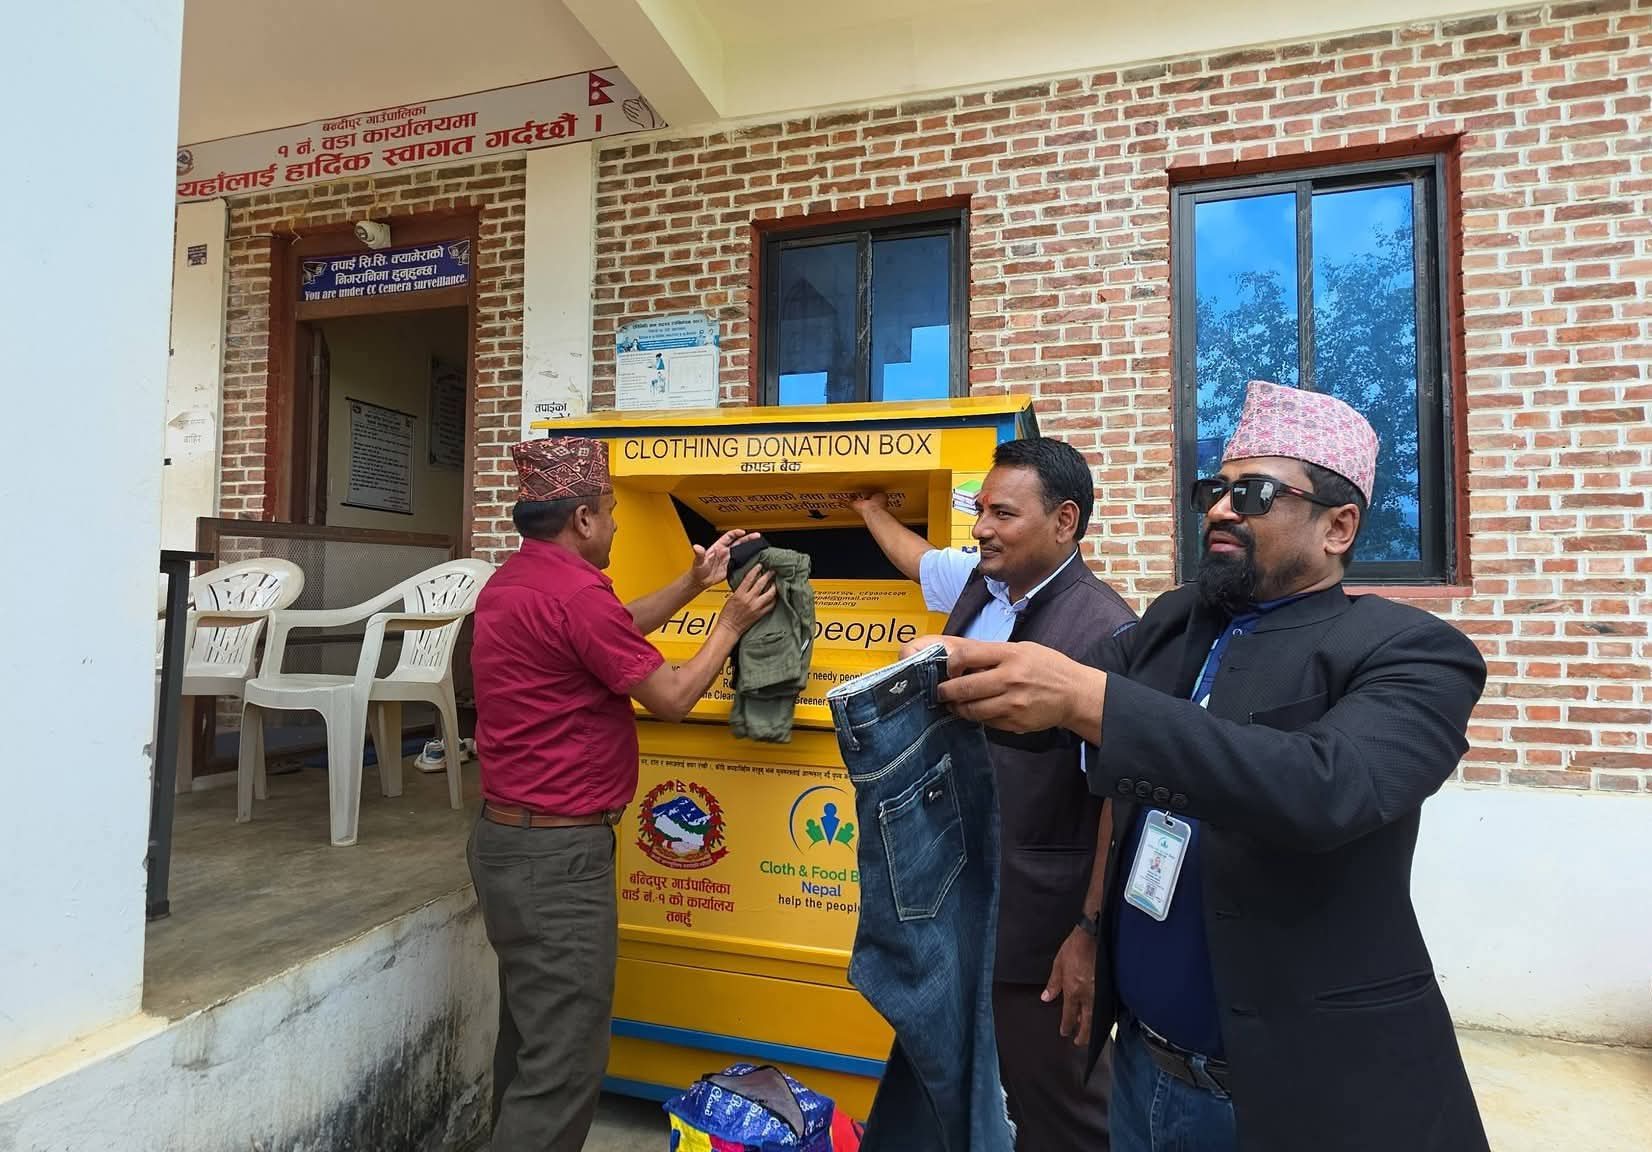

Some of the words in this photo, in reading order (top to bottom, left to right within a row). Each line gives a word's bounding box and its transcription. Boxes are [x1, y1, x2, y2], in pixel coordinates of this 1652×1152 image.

[321, 132, 360, 151] वडा
[362, 111, 478, 143] कार्यालयमा
[285, 152, 373, 182] हार्दिक
[382, 135, 476, 166] स्वागत
[391, 245, 444, 264] क्यामेराको
[304, 291, 320, 301] You
[322, 288, 336, 299] are
[338, 286, 364, 298] under
[366, 284, 376, 295] CC
[378, 281, 411, 294] Cemera
[413, 273, 467, 290] surveillance.
[624, 436, 739, 460] CLOTHING
[746, 434, 870, 457] DONATION
[879, 433, 932, 455] BOX
[740, 461, 776, 472] कपडा
[661, 611, 716, 636] Hel
[813, 671, 838, 683] needy
[760, 860, 795, 876] Cloth
[799, 865, 808, 877] &
[812, 866, 846, 881] Food
[801, 881, 841, 897] Nepal
[669, 892, 683, 906] को
[687, 895, 734, 912] कार्यालय
[778, 893, 801, 908] help
[805, 897, 822, 908] the
[826, 902, 861, 914] peopl
